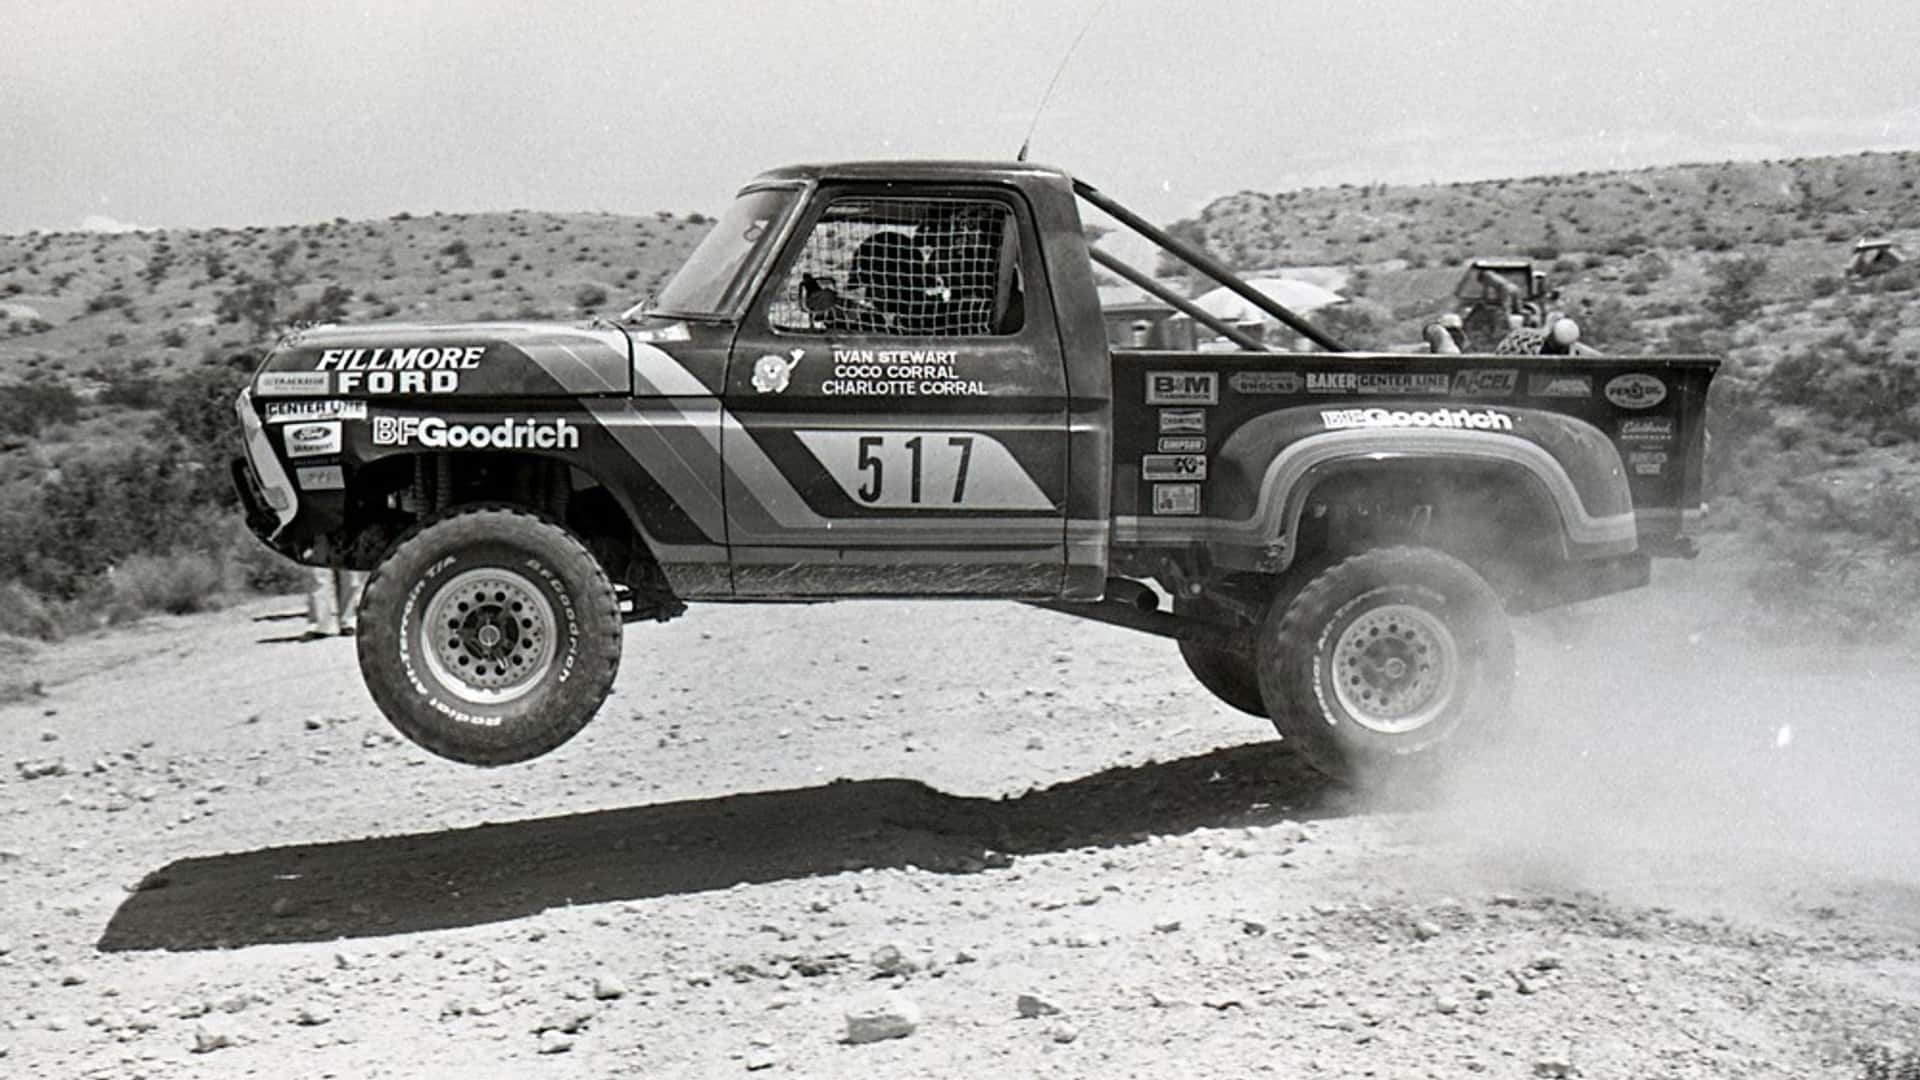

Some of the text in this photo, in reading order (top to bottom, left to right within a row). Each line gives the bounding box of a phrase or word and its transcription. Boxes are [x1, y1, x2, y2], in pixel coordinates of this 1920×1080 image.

[314, 346, 486, 371] FILLMORE
[834, 351, 958, 364] IVAN STEWART
[338, 370, 459, 394] FORD
[835, 366, 959, 379] COCO CORRAL
[1306, 373, 1356, 388] BAKER
[822, 380, 988, 395] CHARLOTTE CORRAL
[268, 401, 326, 416] CENTER
[1320, 407, 1513, 430] BFGoodrich
[372, 415, 580, 448] BFGoodrich
[857, 436, 974, 504] 517
[427, 697, 502, 727] Radial
